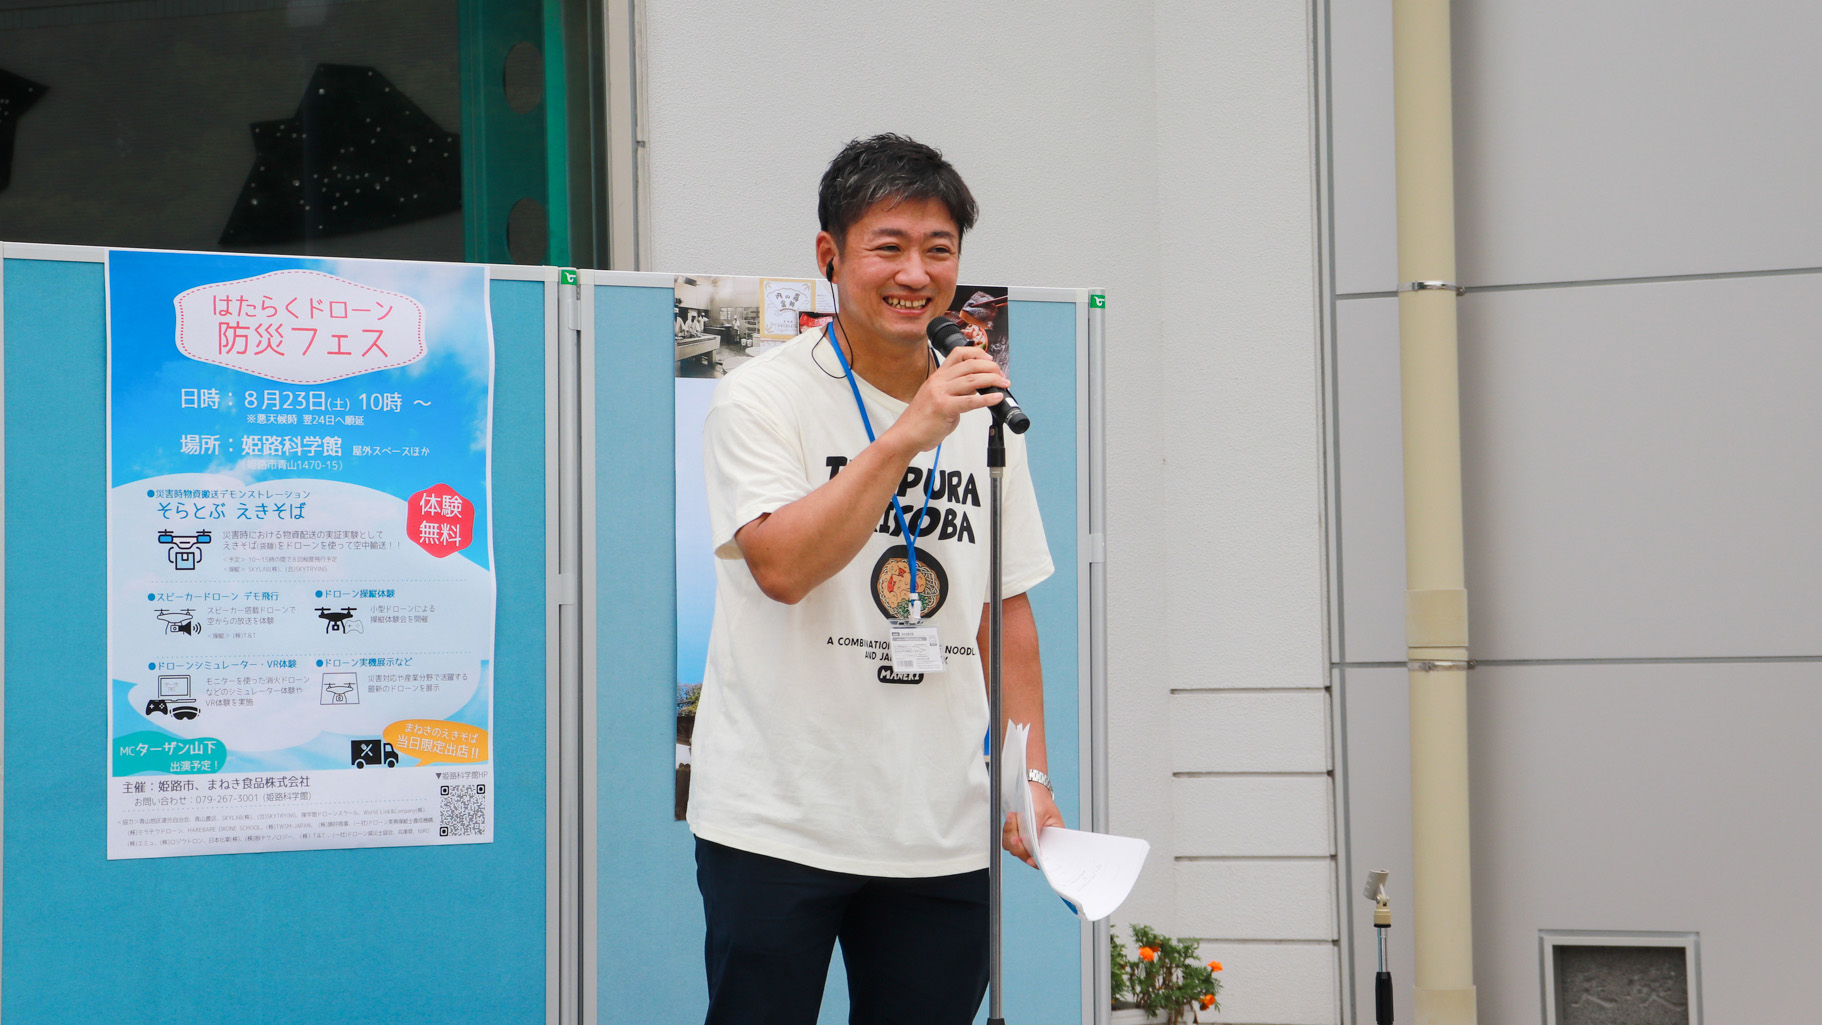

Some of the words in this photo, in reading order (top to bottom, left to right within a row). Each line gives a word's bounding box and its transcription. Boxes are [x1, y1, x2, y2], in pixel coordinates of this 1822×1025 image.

[212, 294, 393, 321] はたらくドローン
[217, 321, 388, 358] 防災フェス
[352, 446, 430, 457] 屋外スペースほか
[826, 456, 981, 507] TPURA
[157, 502, 226, 520] そらとぶ
[236, 502, 306, 520] えきそば
[419, 492, 463, 518] 体験
[874, 500, 976, 544] ISOBA
[419, 520, 462, 547] 無料
[156, 592, 239, 602] スピーカードローン
[243, 591, 280, 601] デモ飛行
[324, 588, 396, 598] ドローン操縦体験
[826, 636, 834, 646] A
[837, 637, 890, 650] COMBINATIO
[944, 645, 976, 656] NOODL
[864, 651, 877, 660] AND
[404, 722, 479, 744] まねきのえきそば
